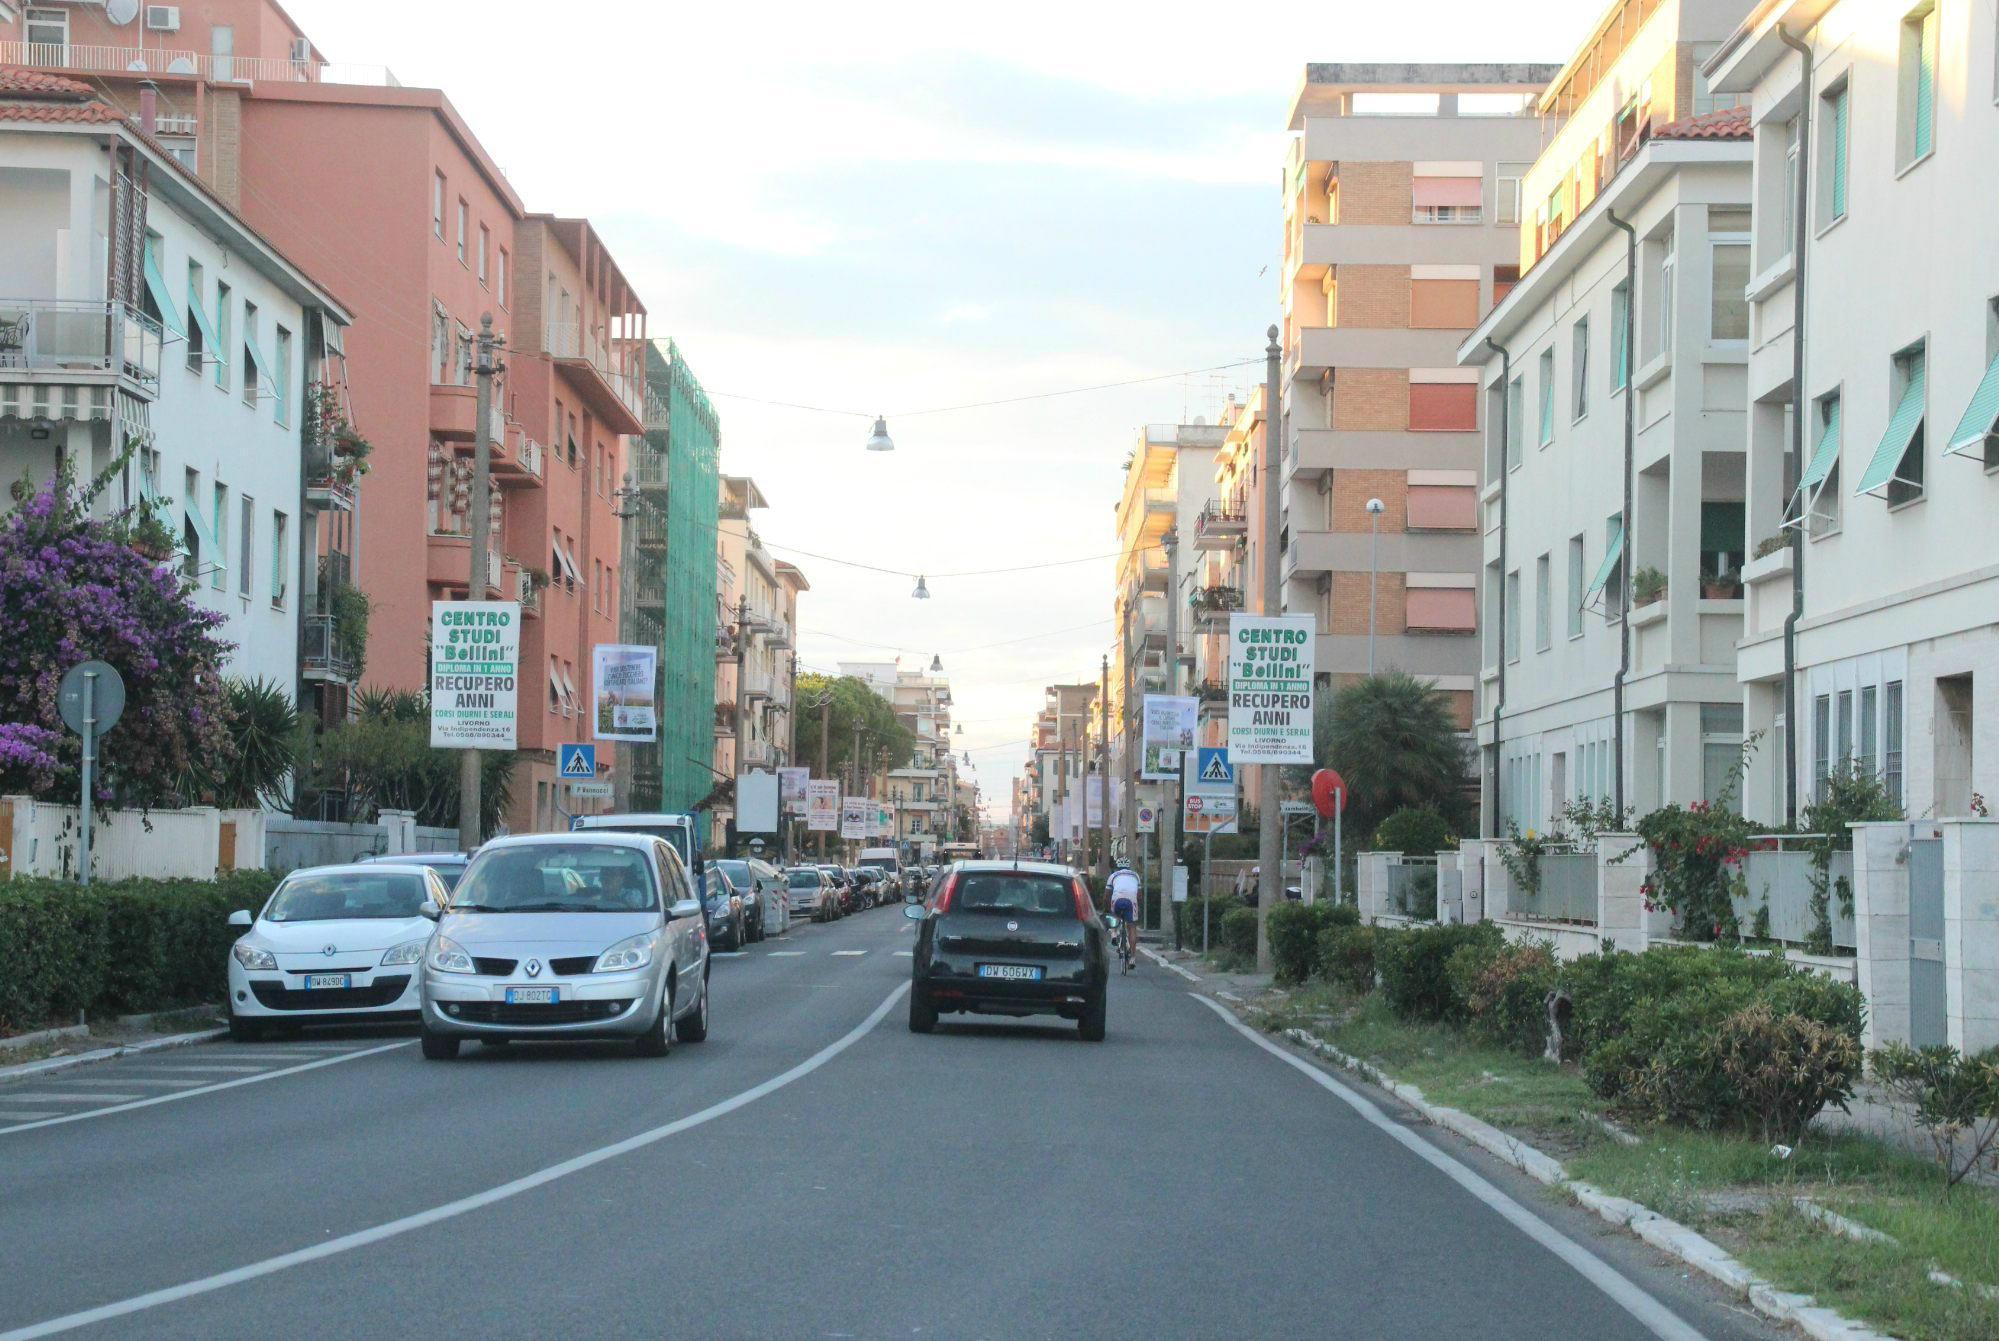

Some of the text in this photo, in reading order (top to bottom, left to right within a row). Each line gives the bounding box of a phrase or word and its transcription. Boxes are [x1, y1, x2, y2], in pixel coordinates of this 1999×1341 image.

[441, 611, 510, 626] CENTRO
[449, 628, 501, 644] STUDI
[1239, 628, 1307, 644] CENTRO
[1246, 646, 1298, 661] STUDI
[437, 663, 471, 673] DIPLOMA
[473, 664, 481, 673] IN
[490, 664, 512, 674] ANNO
[435, 676, 514, 691] RECUPERO
[1235, 681, 1269, 690] DIPLOMA
[1270, 682, 1279, 691] IN
[1286, 682, 1308, 691] ANNO
[455, 693, 495, 708] ANNI
[1232, 694, 1310, 709] RECUPERO
[435, 710, 455, 718] CORSI
[457, 710, 482, 718] DIURNI
[490, 711, 514, 719] SERALI
[1252, 711, 1290, 726] ANNI
[1254, 728, 1278, 736] DIURNI
[1286, 728, 1310, 736] SERALI
[986, 966, 1034, 978] DW 606WX
